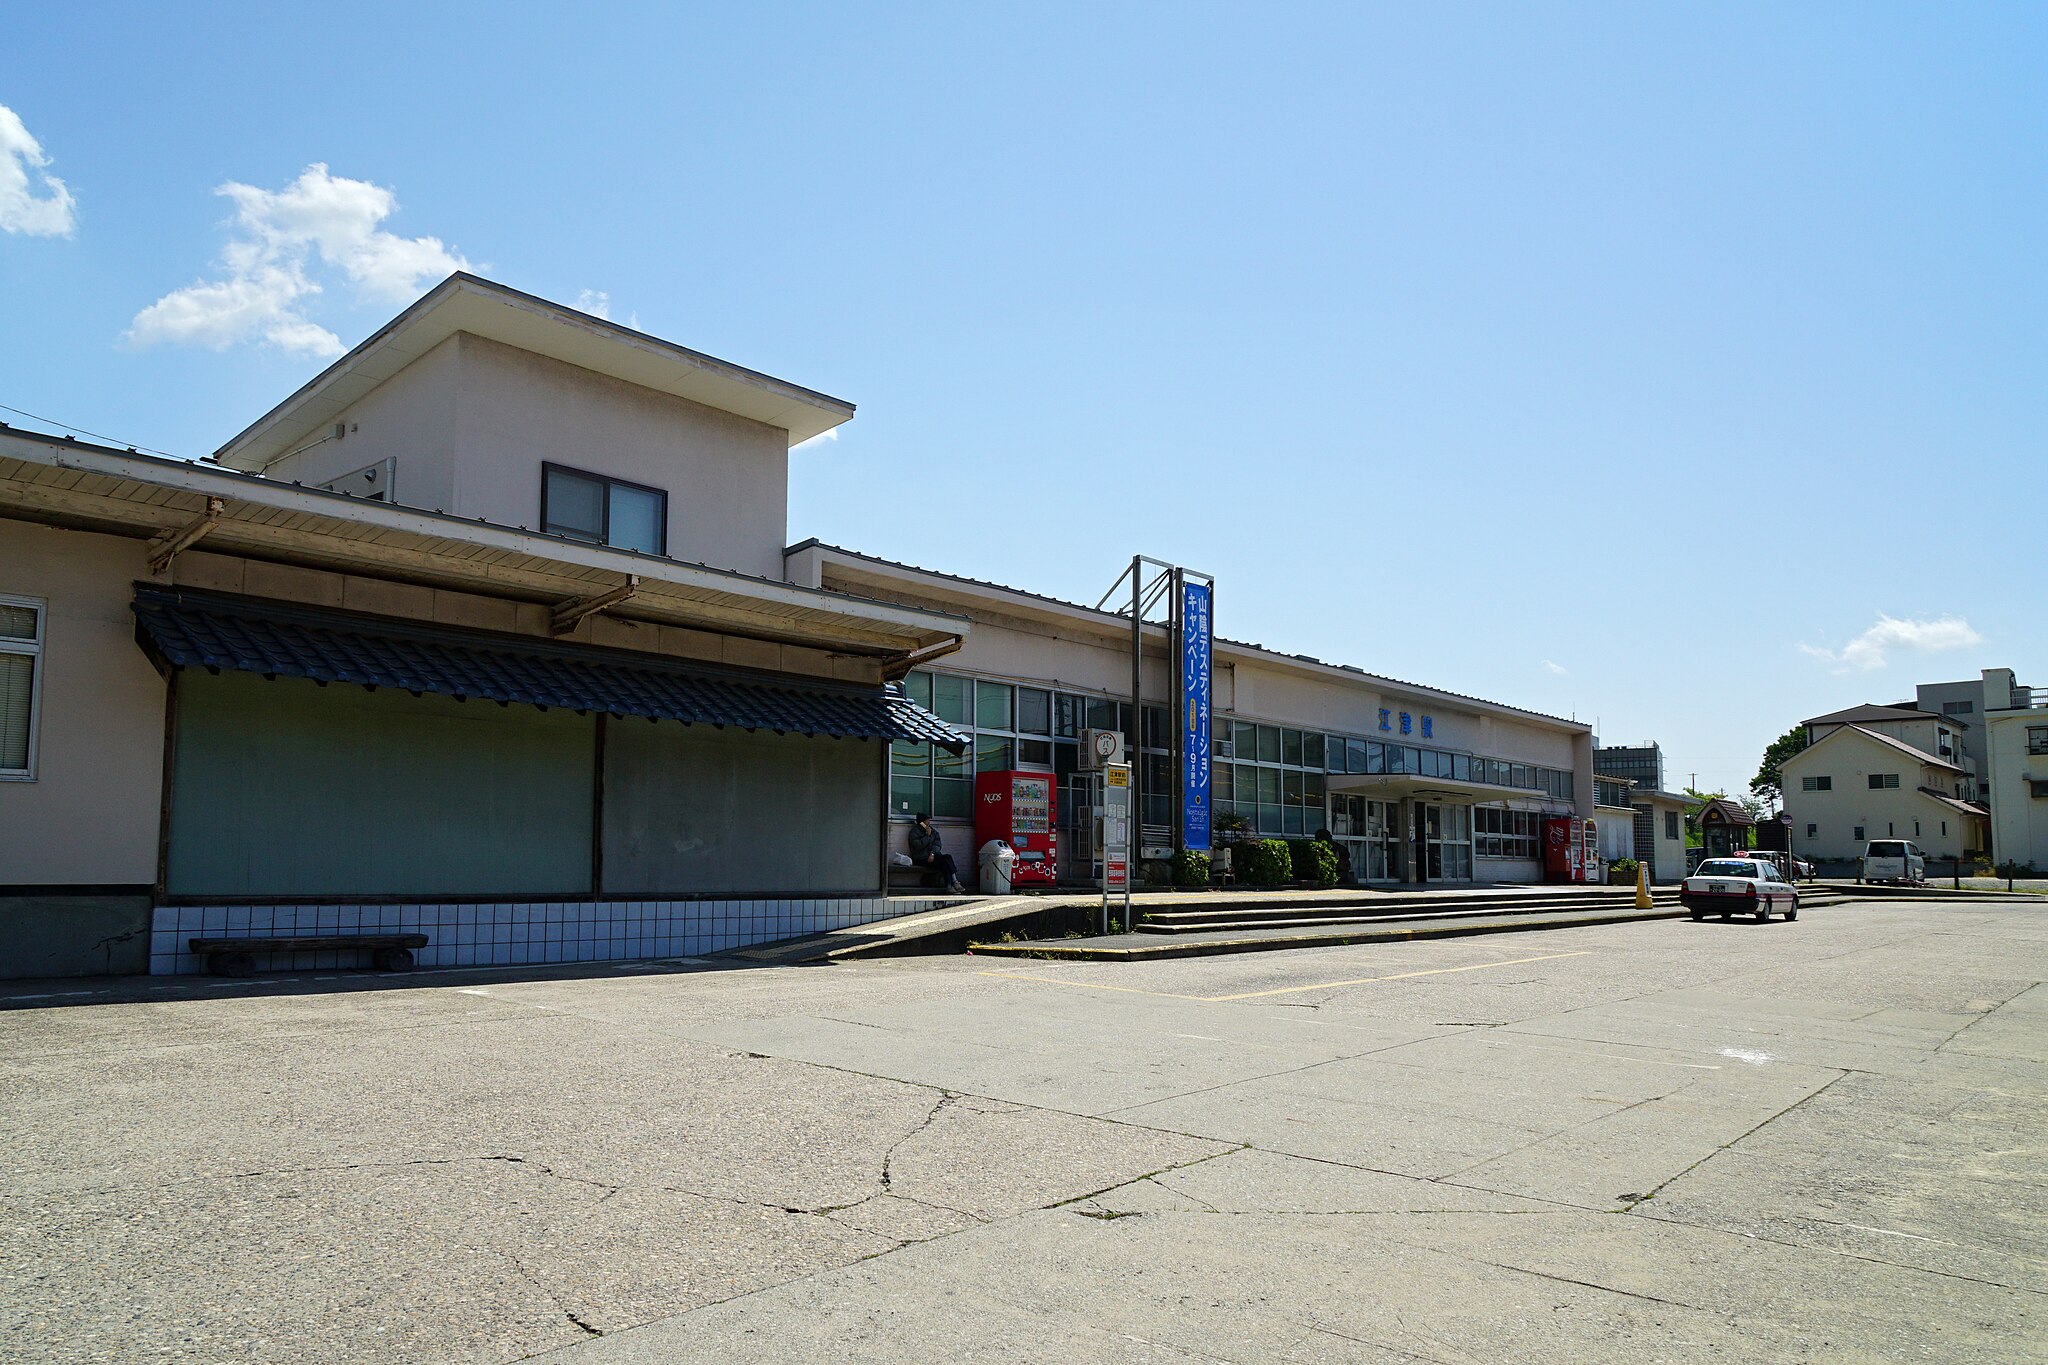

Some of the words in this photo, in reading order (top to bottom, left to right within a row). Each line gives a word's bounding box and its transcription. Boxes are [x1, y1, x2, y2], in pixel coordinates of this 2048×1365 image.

[1187, 593, 1198, 691] キャンペーン
[1198, 595, 1208, 788] 山陰デスティネーション
[1378, 707, 1433, 738] 江津駅
